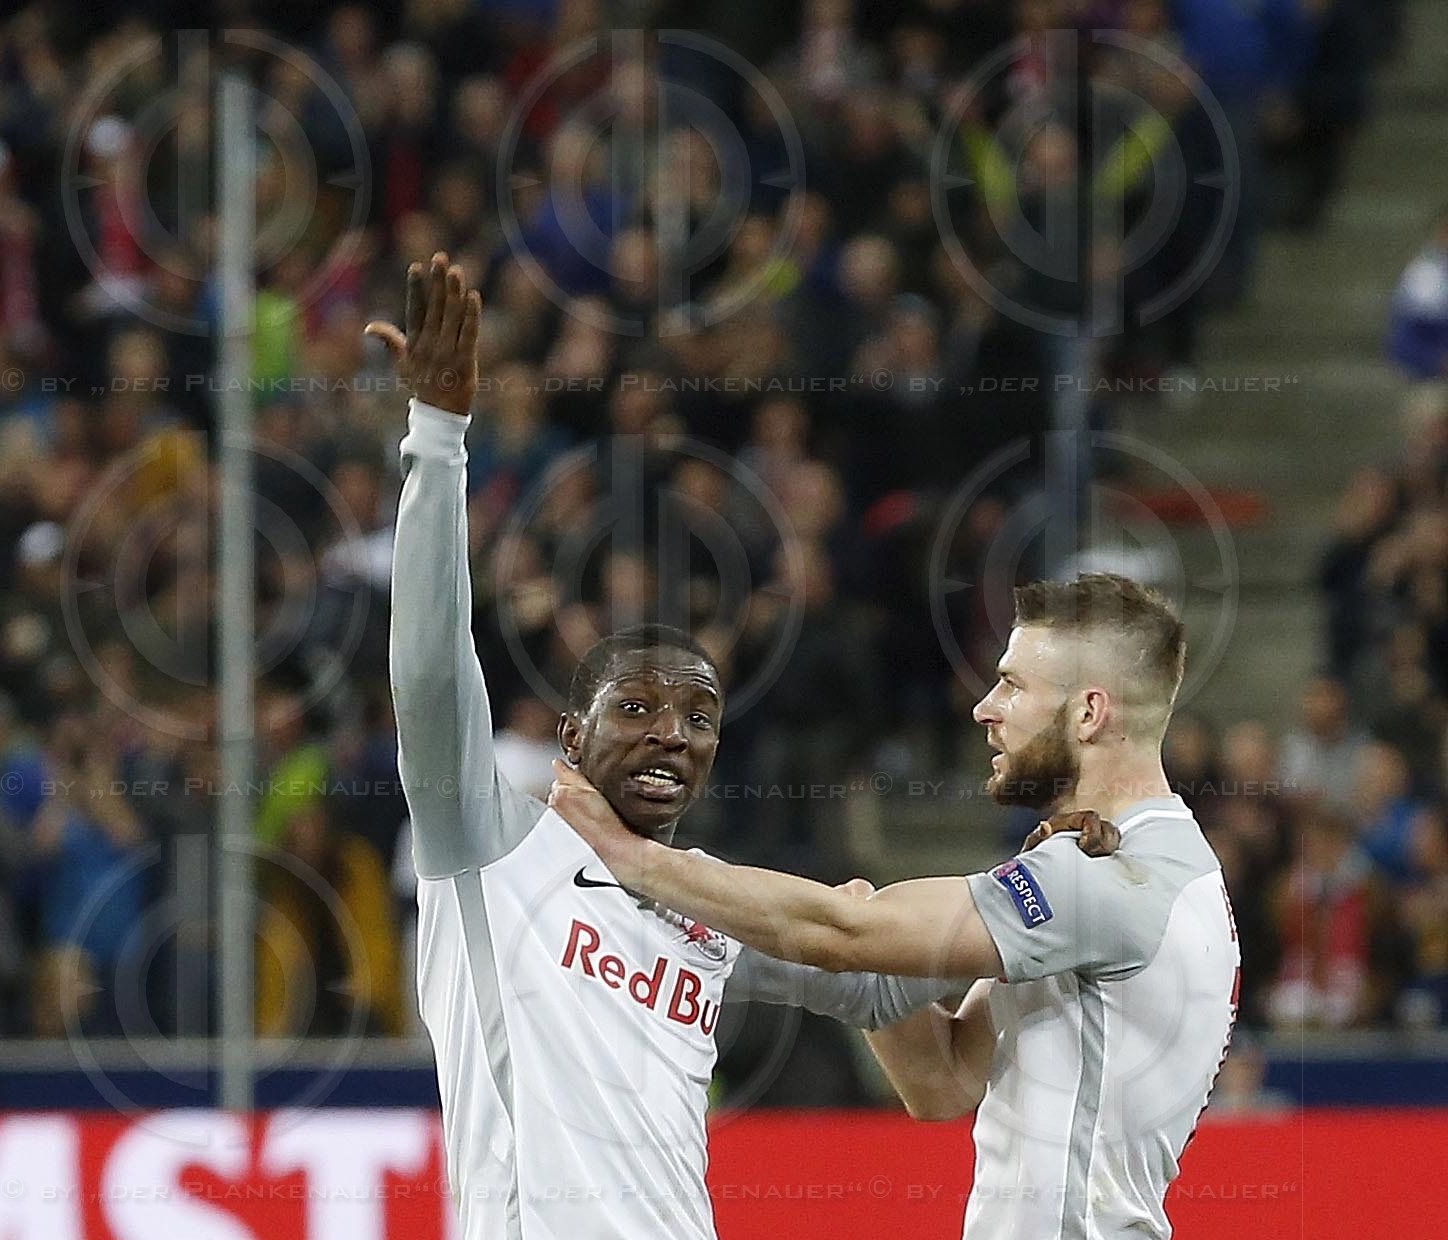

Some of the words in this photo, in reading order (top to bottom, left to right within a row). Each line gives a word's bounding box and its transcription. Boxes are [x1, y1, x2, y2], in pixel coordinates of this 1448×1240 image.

[1006, 869, 1046, 923] RESPECT
[560, 918, 669, 1011] Red
[666, 967, 721, 1037] Bu
